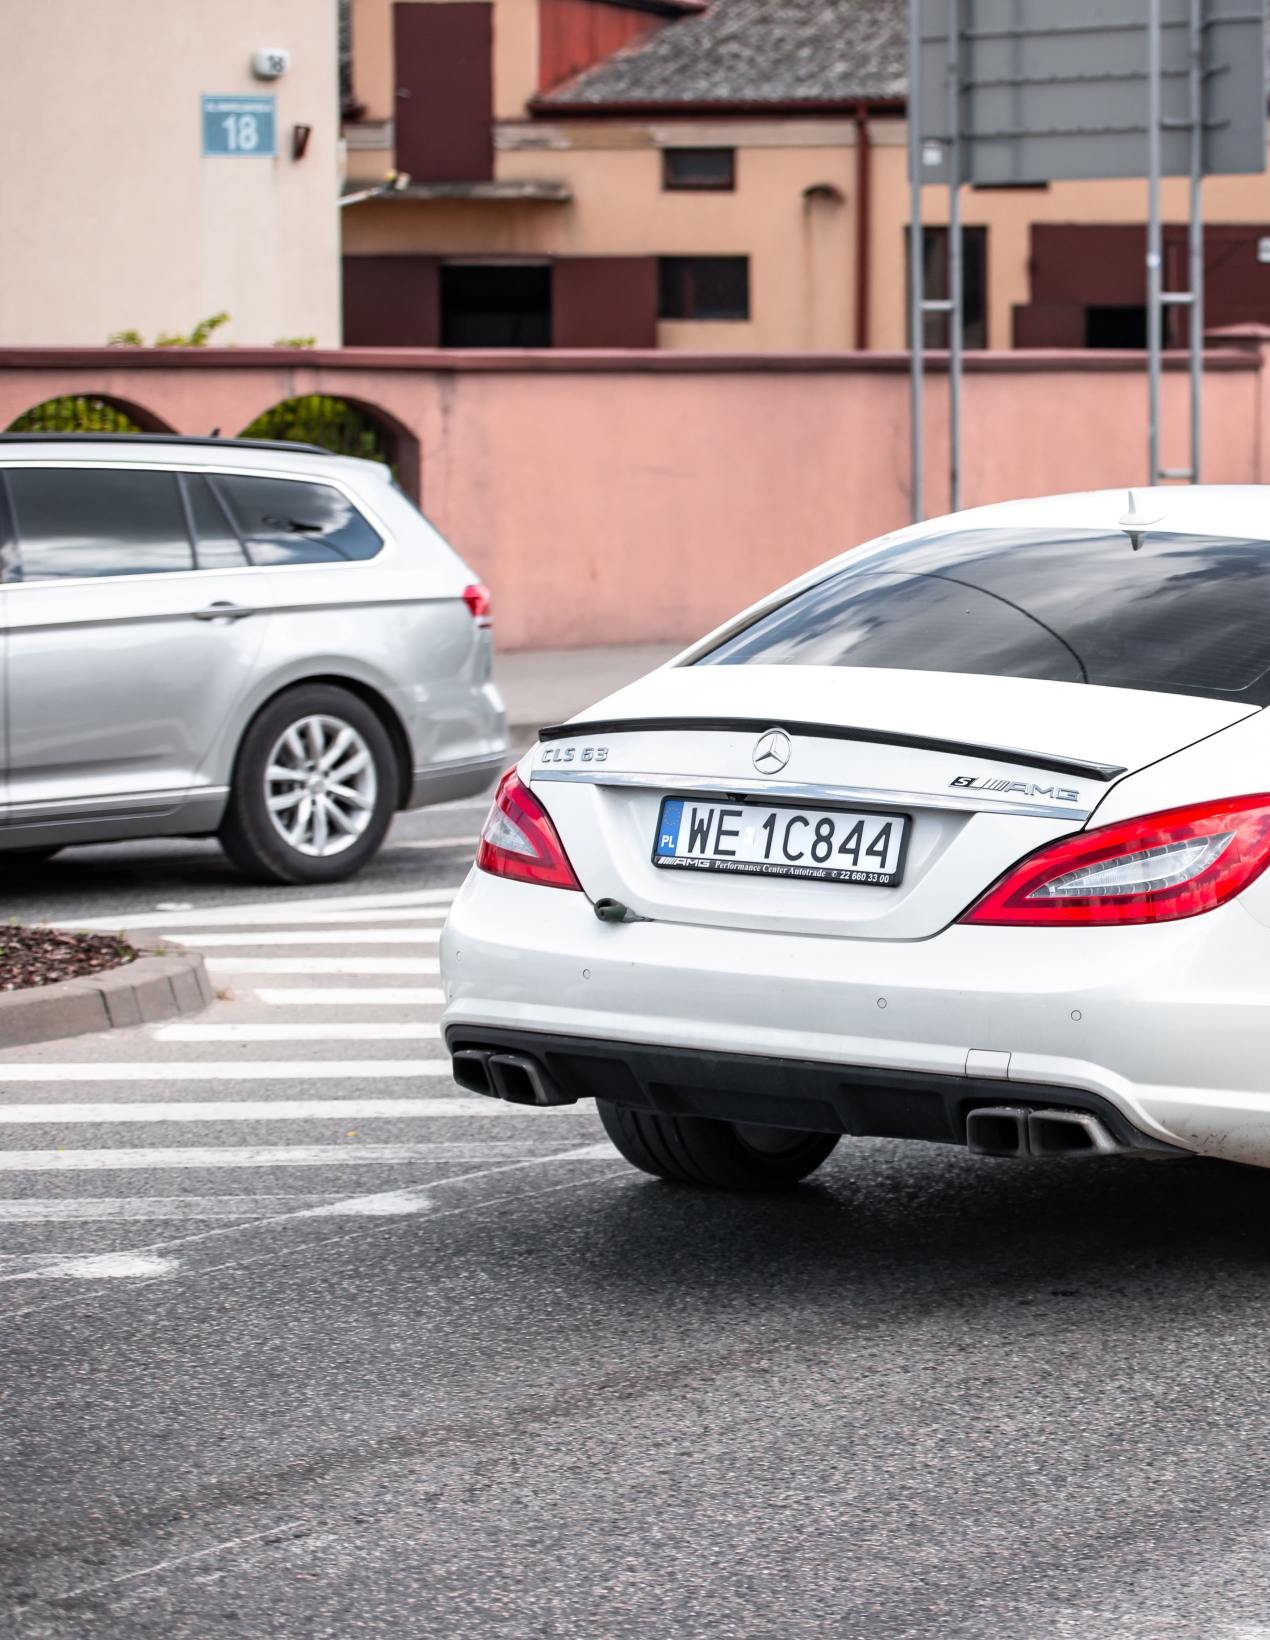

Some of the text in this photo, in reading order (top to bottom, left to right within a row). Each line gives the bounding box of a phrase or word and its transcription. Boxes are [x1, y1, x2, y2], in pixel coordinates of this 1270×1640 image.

[267, 55, 284, 73] 18
[222, 114, 259, 151] 18
[541, 747, 609, 763] CLS 63
[1004, 780, 1080, 802] AMG
[661, 835, 675, 848] PL
[687, 807, 893, 869] WE 1C844
[673, 858, 890, 884] AMG Performance Center Autotrade 22 660 33 00
